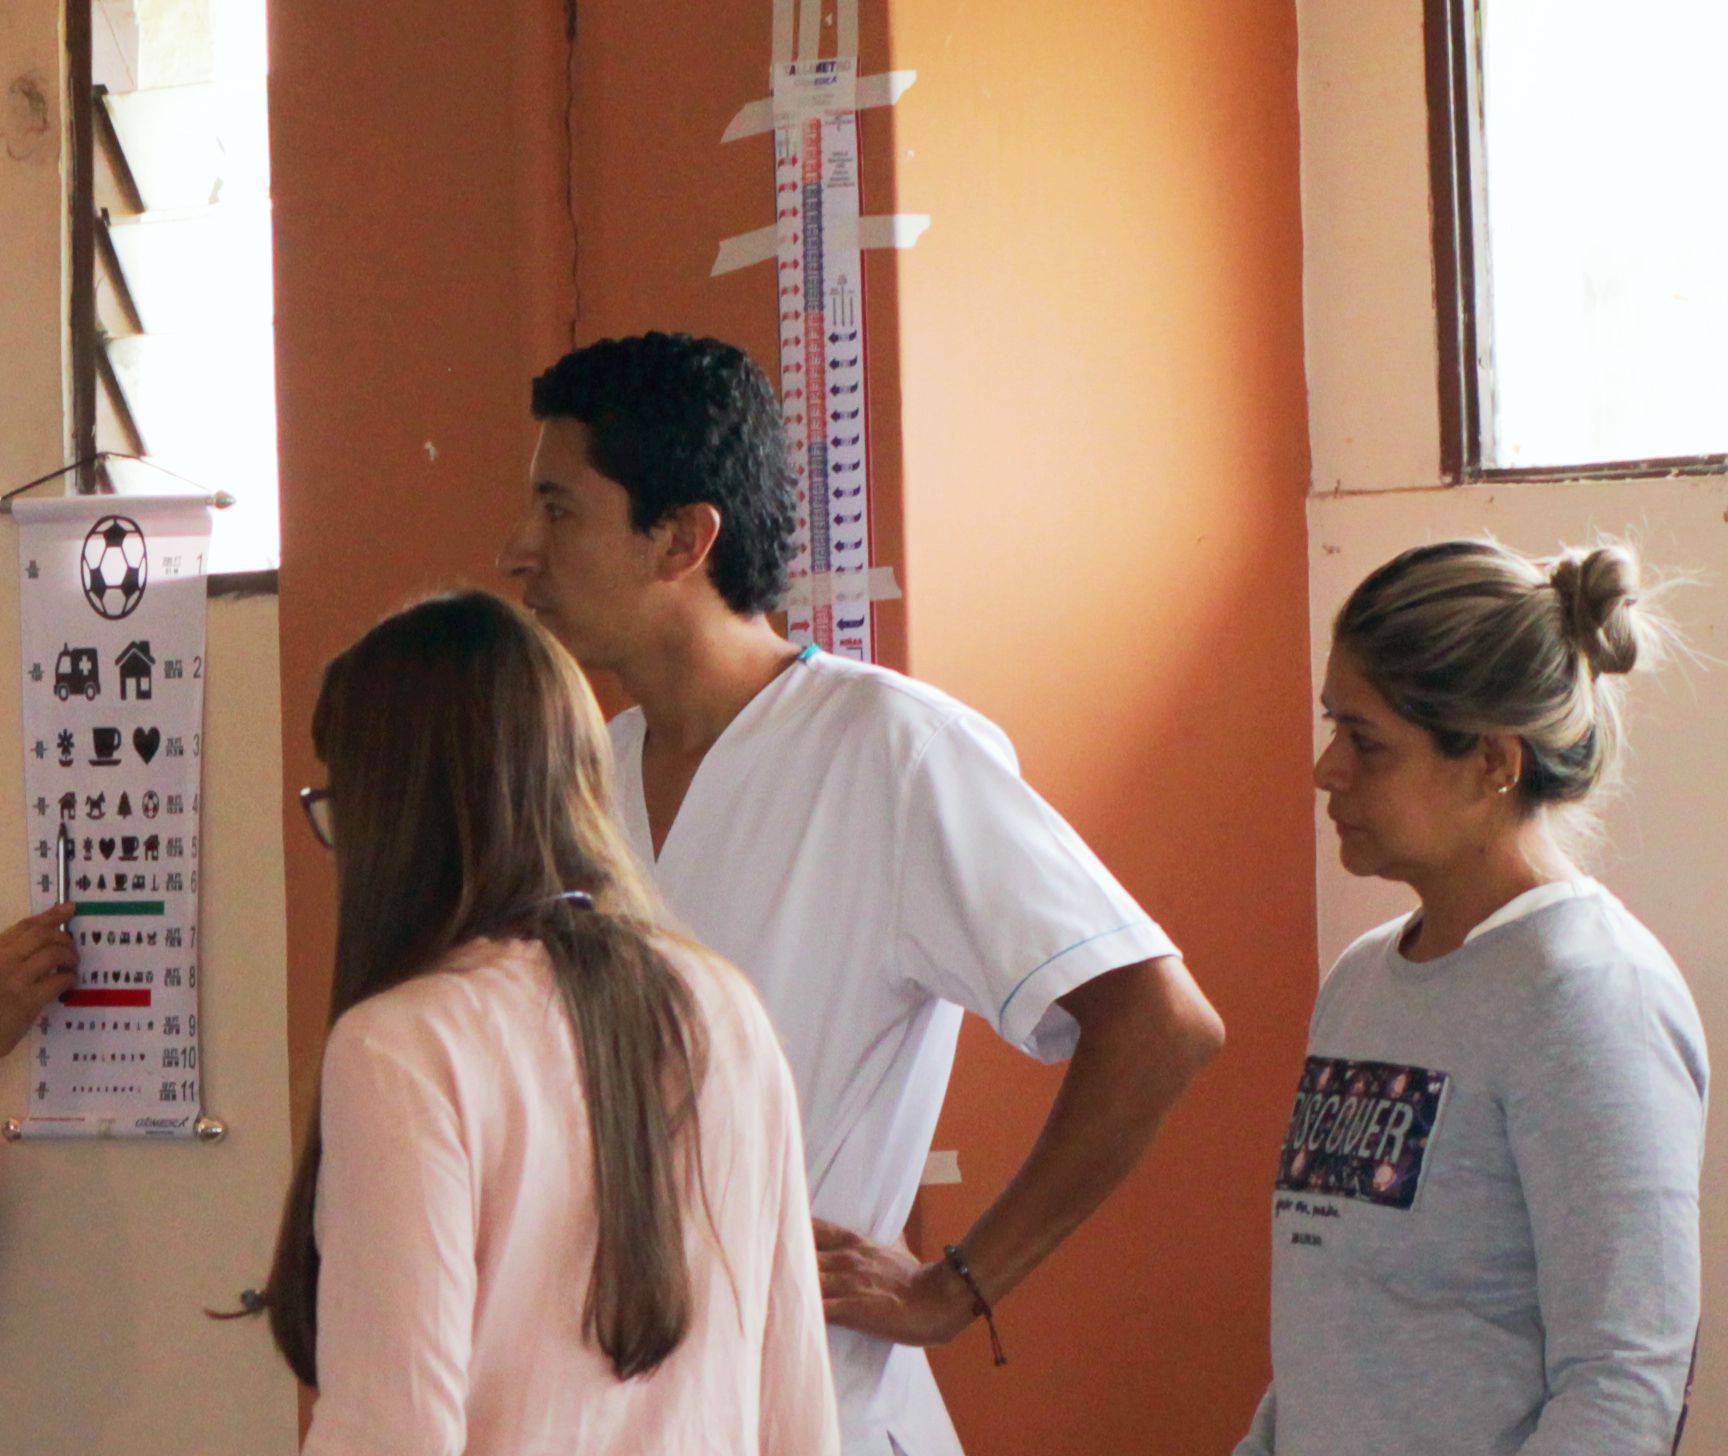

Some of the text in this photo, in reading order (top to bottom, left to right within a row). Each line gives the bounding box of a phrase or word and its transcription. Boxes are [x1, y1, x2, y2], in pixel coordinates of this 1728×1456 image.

[192, 655, 202, 679] 2
[192, 734, 201, 757] 3
[188, 1014, 197, 1037] 9
[181, 1046, 197, 1070] 10
